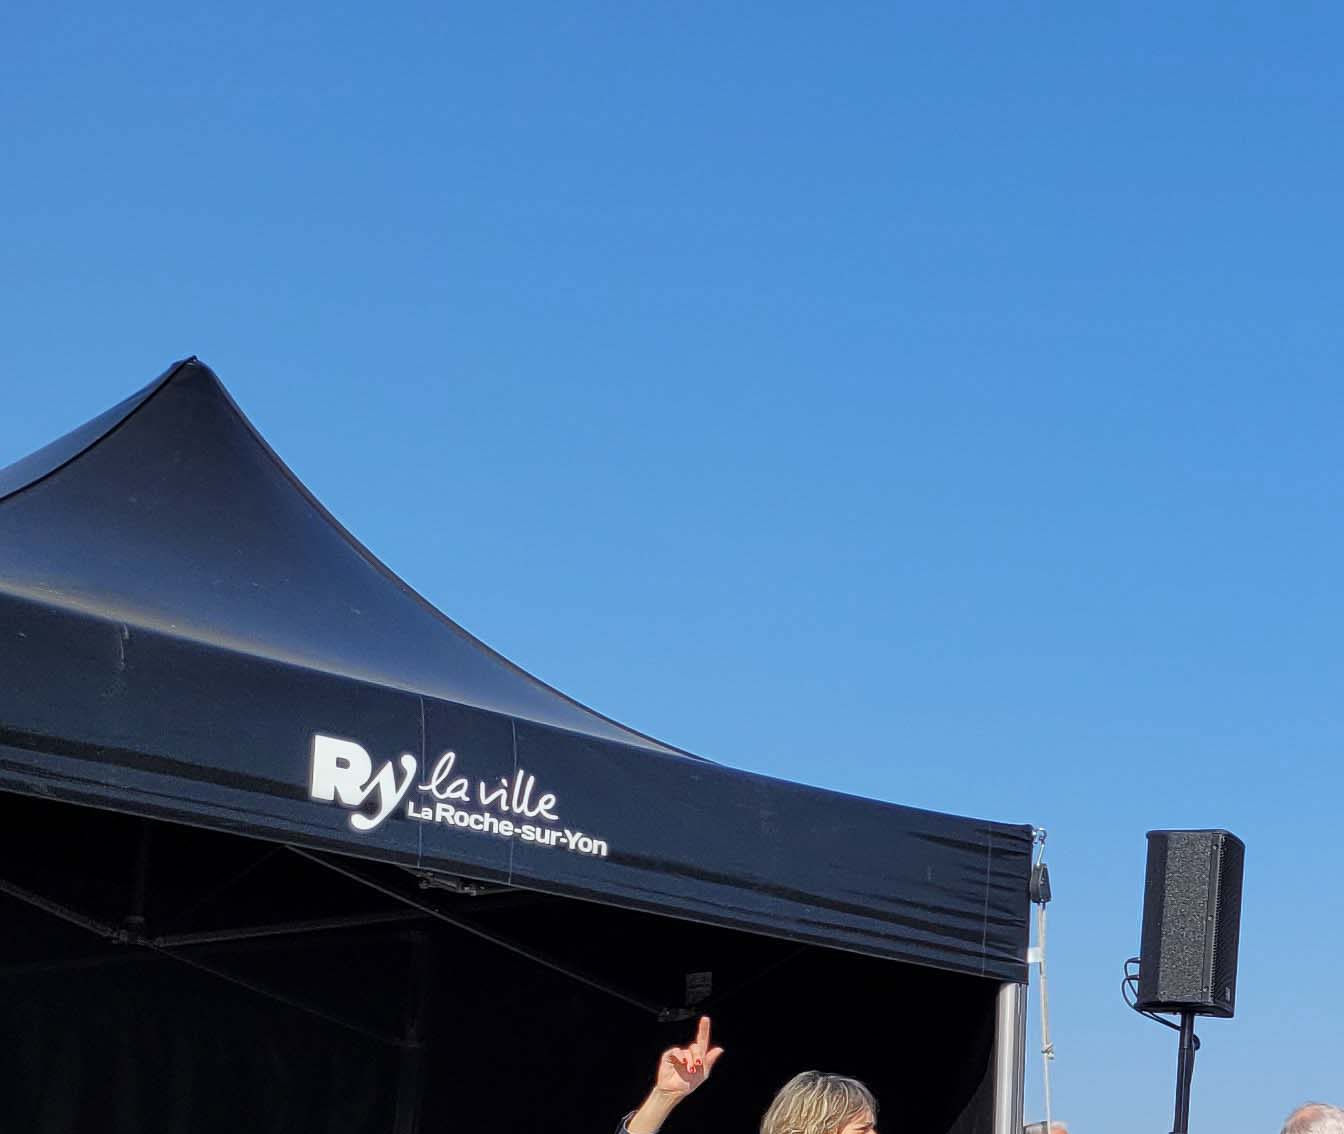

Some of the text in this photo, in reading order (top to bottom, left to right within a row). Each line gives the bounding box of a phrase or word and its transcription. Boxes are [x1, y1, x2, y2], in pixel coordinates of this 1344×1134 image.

[311, 734, 417, 830] Ry
[418, 751, 560, 821] la ville
[407, 801, 609, 857] La Roche-sur-Yon
